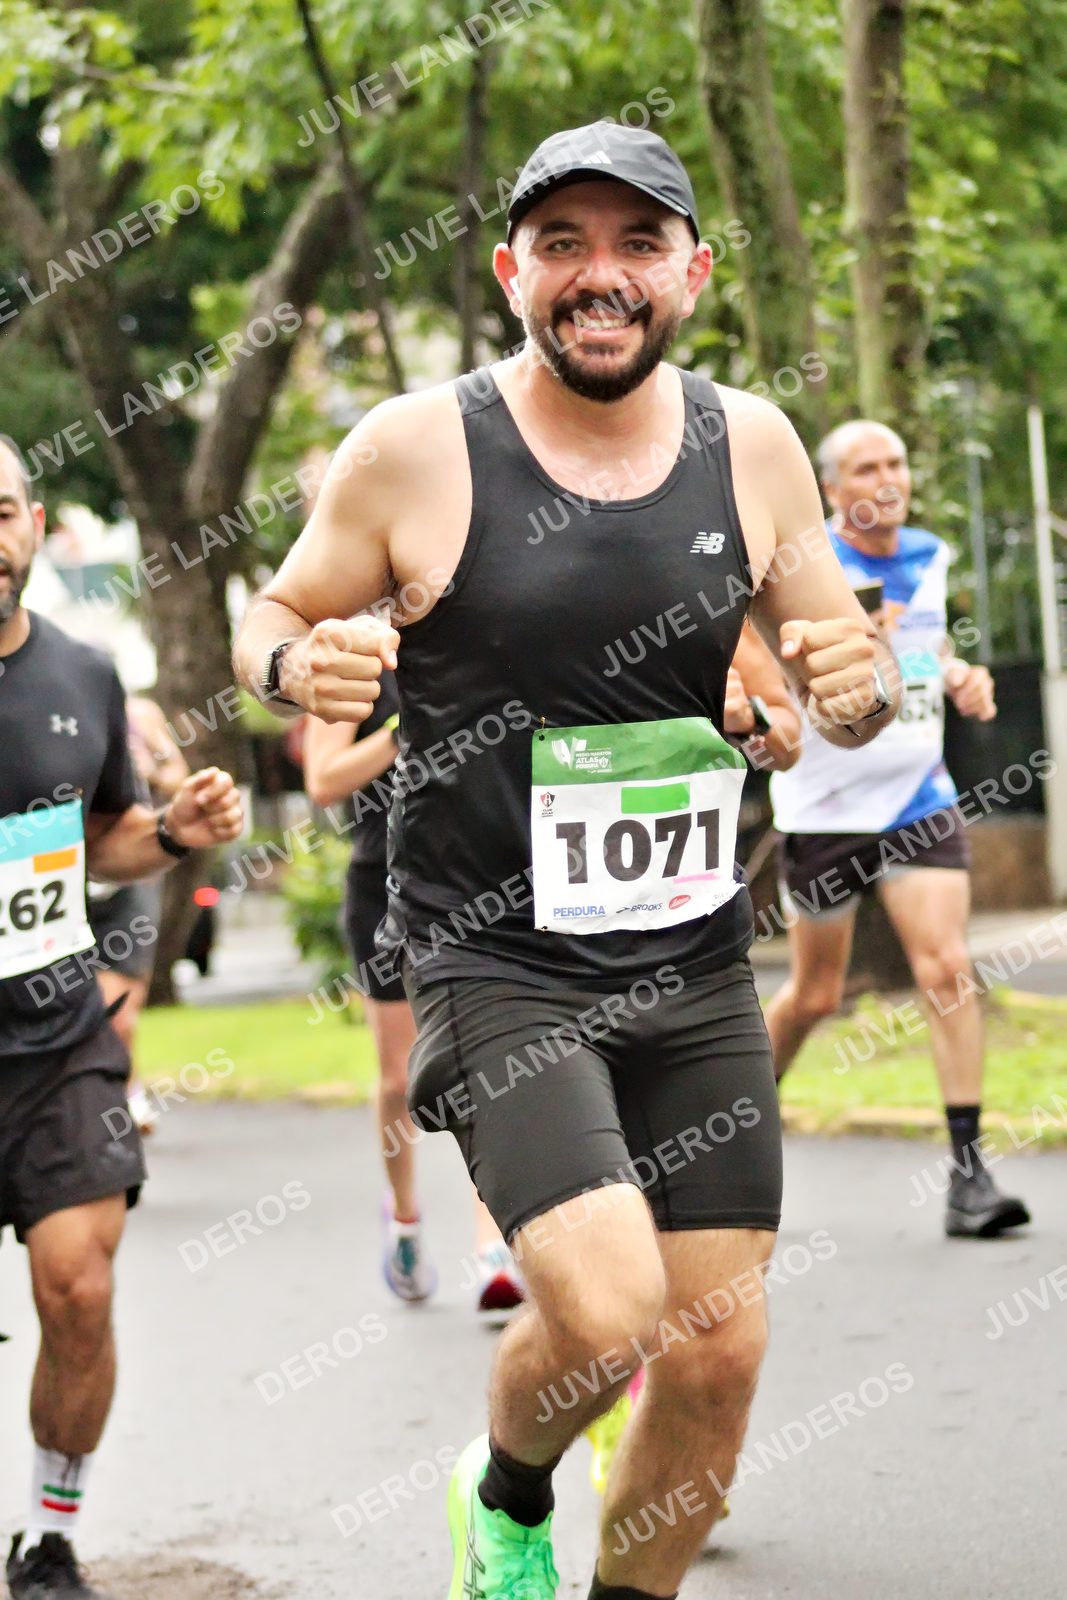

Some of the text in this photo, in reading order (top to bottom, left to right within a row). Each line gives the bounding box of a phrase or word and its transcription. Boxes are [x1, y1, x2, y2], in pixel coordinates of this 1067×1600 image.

[555, 808, 720, 885] 1071
[553, 905, 606, 917] PERDURA
[630, 903, 663, 912] BROOKS
